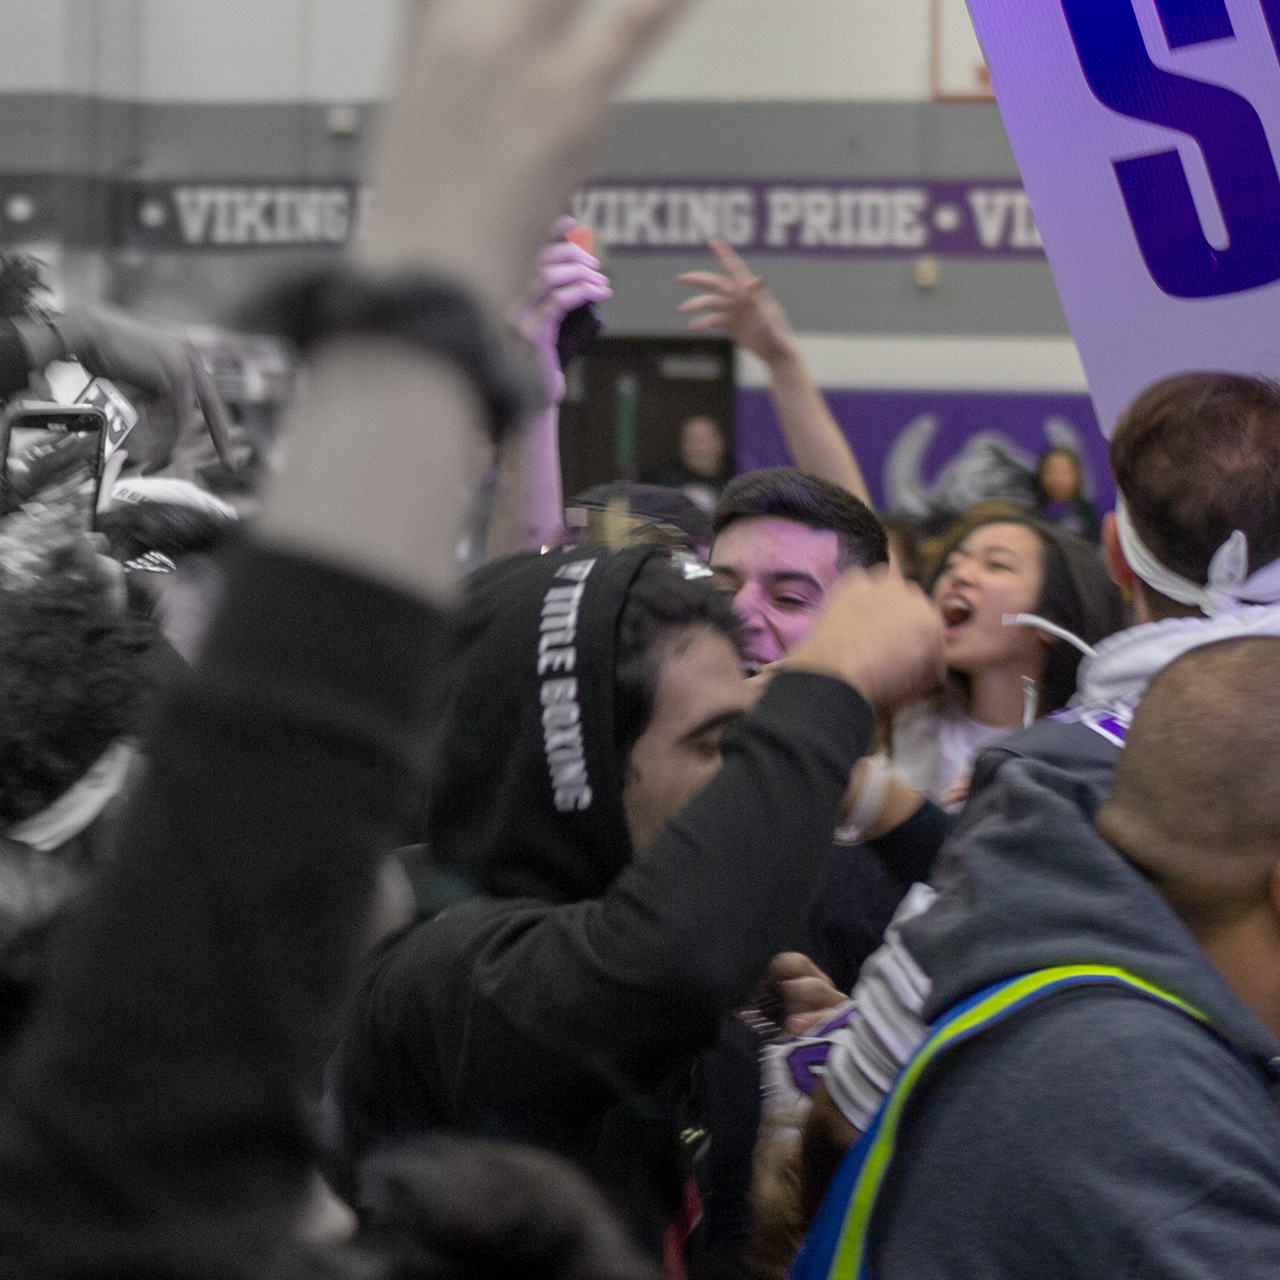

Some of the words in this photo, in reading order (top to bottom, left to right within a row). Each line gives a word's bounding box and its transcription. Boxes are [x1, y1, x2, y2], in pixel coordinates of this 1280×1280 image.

[173, 187, 350, 244] VIKING
[570, 188, 754, 246] VIKING
[767, 189, 927, 248] PRIDE
[539, 677, 594, 812] BOXING
